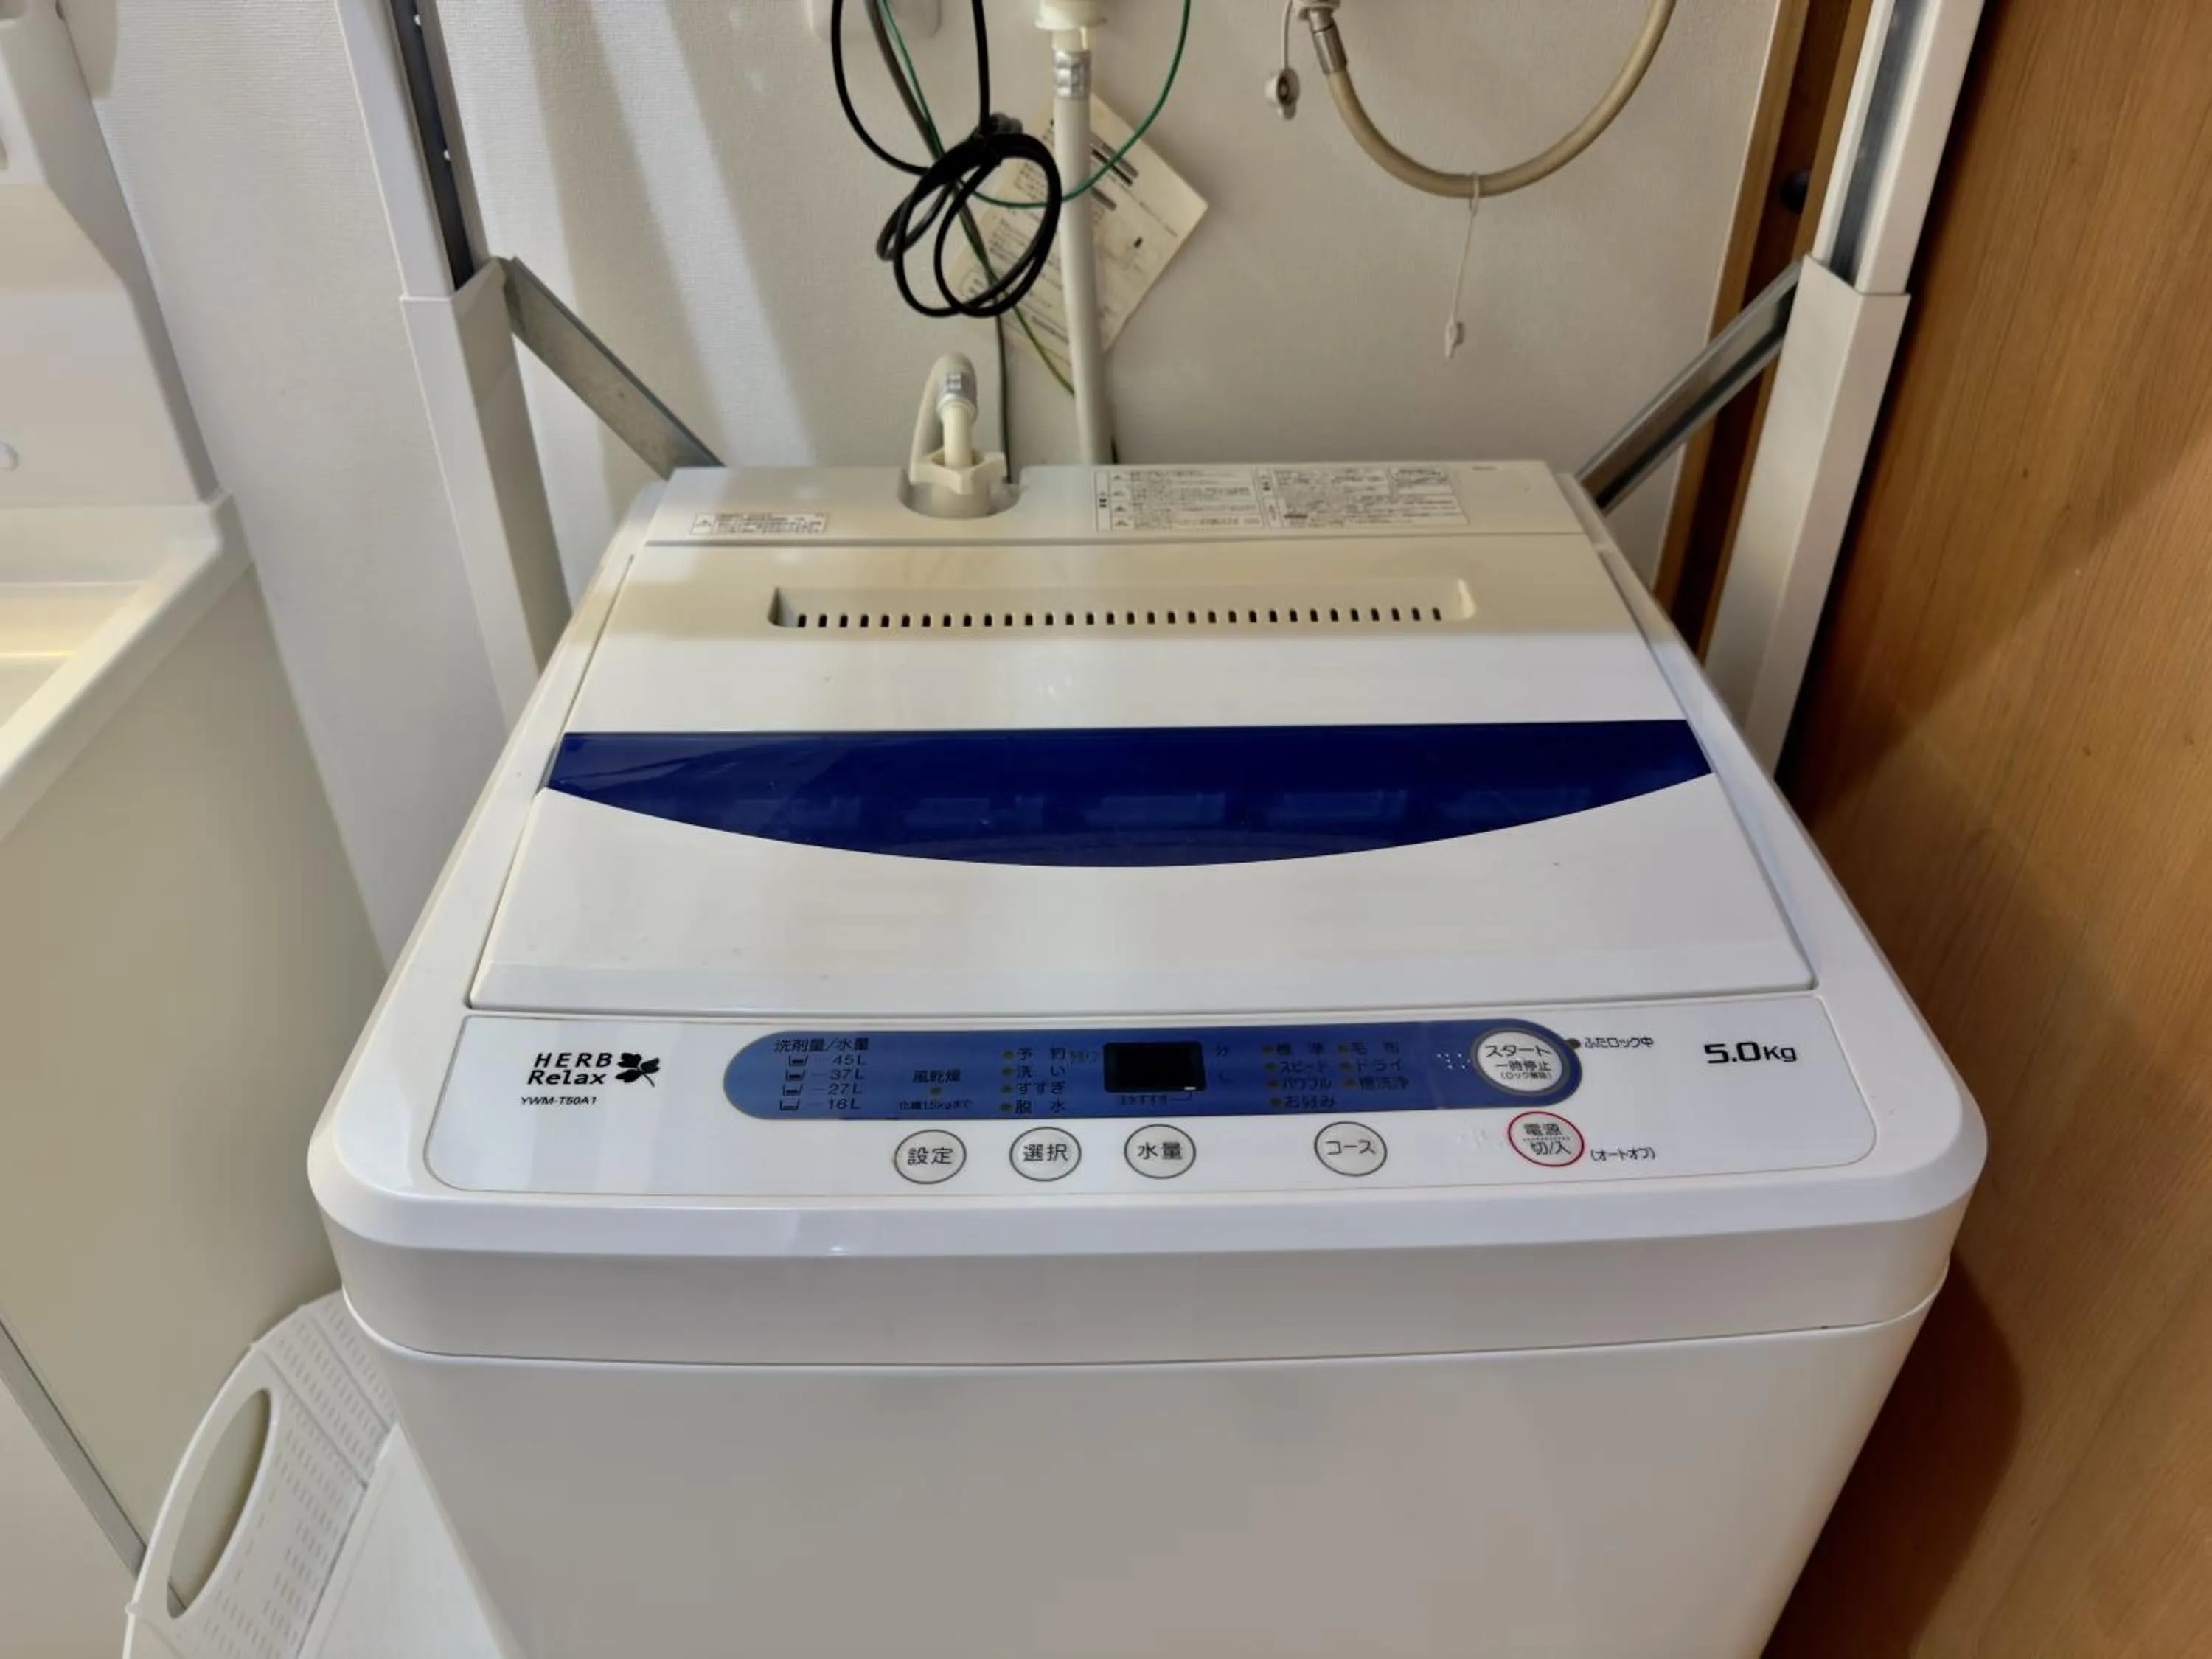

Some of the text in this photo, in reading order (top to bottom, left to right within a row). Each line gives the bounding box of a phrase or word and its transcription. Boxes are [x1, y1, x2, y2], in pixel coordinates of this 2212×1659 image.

[1485, 1045, 1551, 1059] スタート
[533, 1052, 613, 1068] HERB
[832, 1054, 866, 1065] 45L
[1356, 1059, 1402, 1073] ドライ
[1494, 1060, 1551, 1072] 一時停止
[527, 1069, 608, 1085] Relax
[831, 1068, 864, 1080] 37L
[828, 1083, 862, 1095] 27L
[1017, 1081, 1065, 1095] すすぎ
[521, 1096, 597, 1106] YWM-T50A1
[830, 1097, 860, 1110] 16L
[1523, 1123, 1563, 1137] 電源
[1023, 1143, 1068, 1163] 選択
[1137, 1141, 1183, 1161] 水量
[1325, 1139, 1377, 1155] コース
[908, 1147, 954, 1166] 設定
